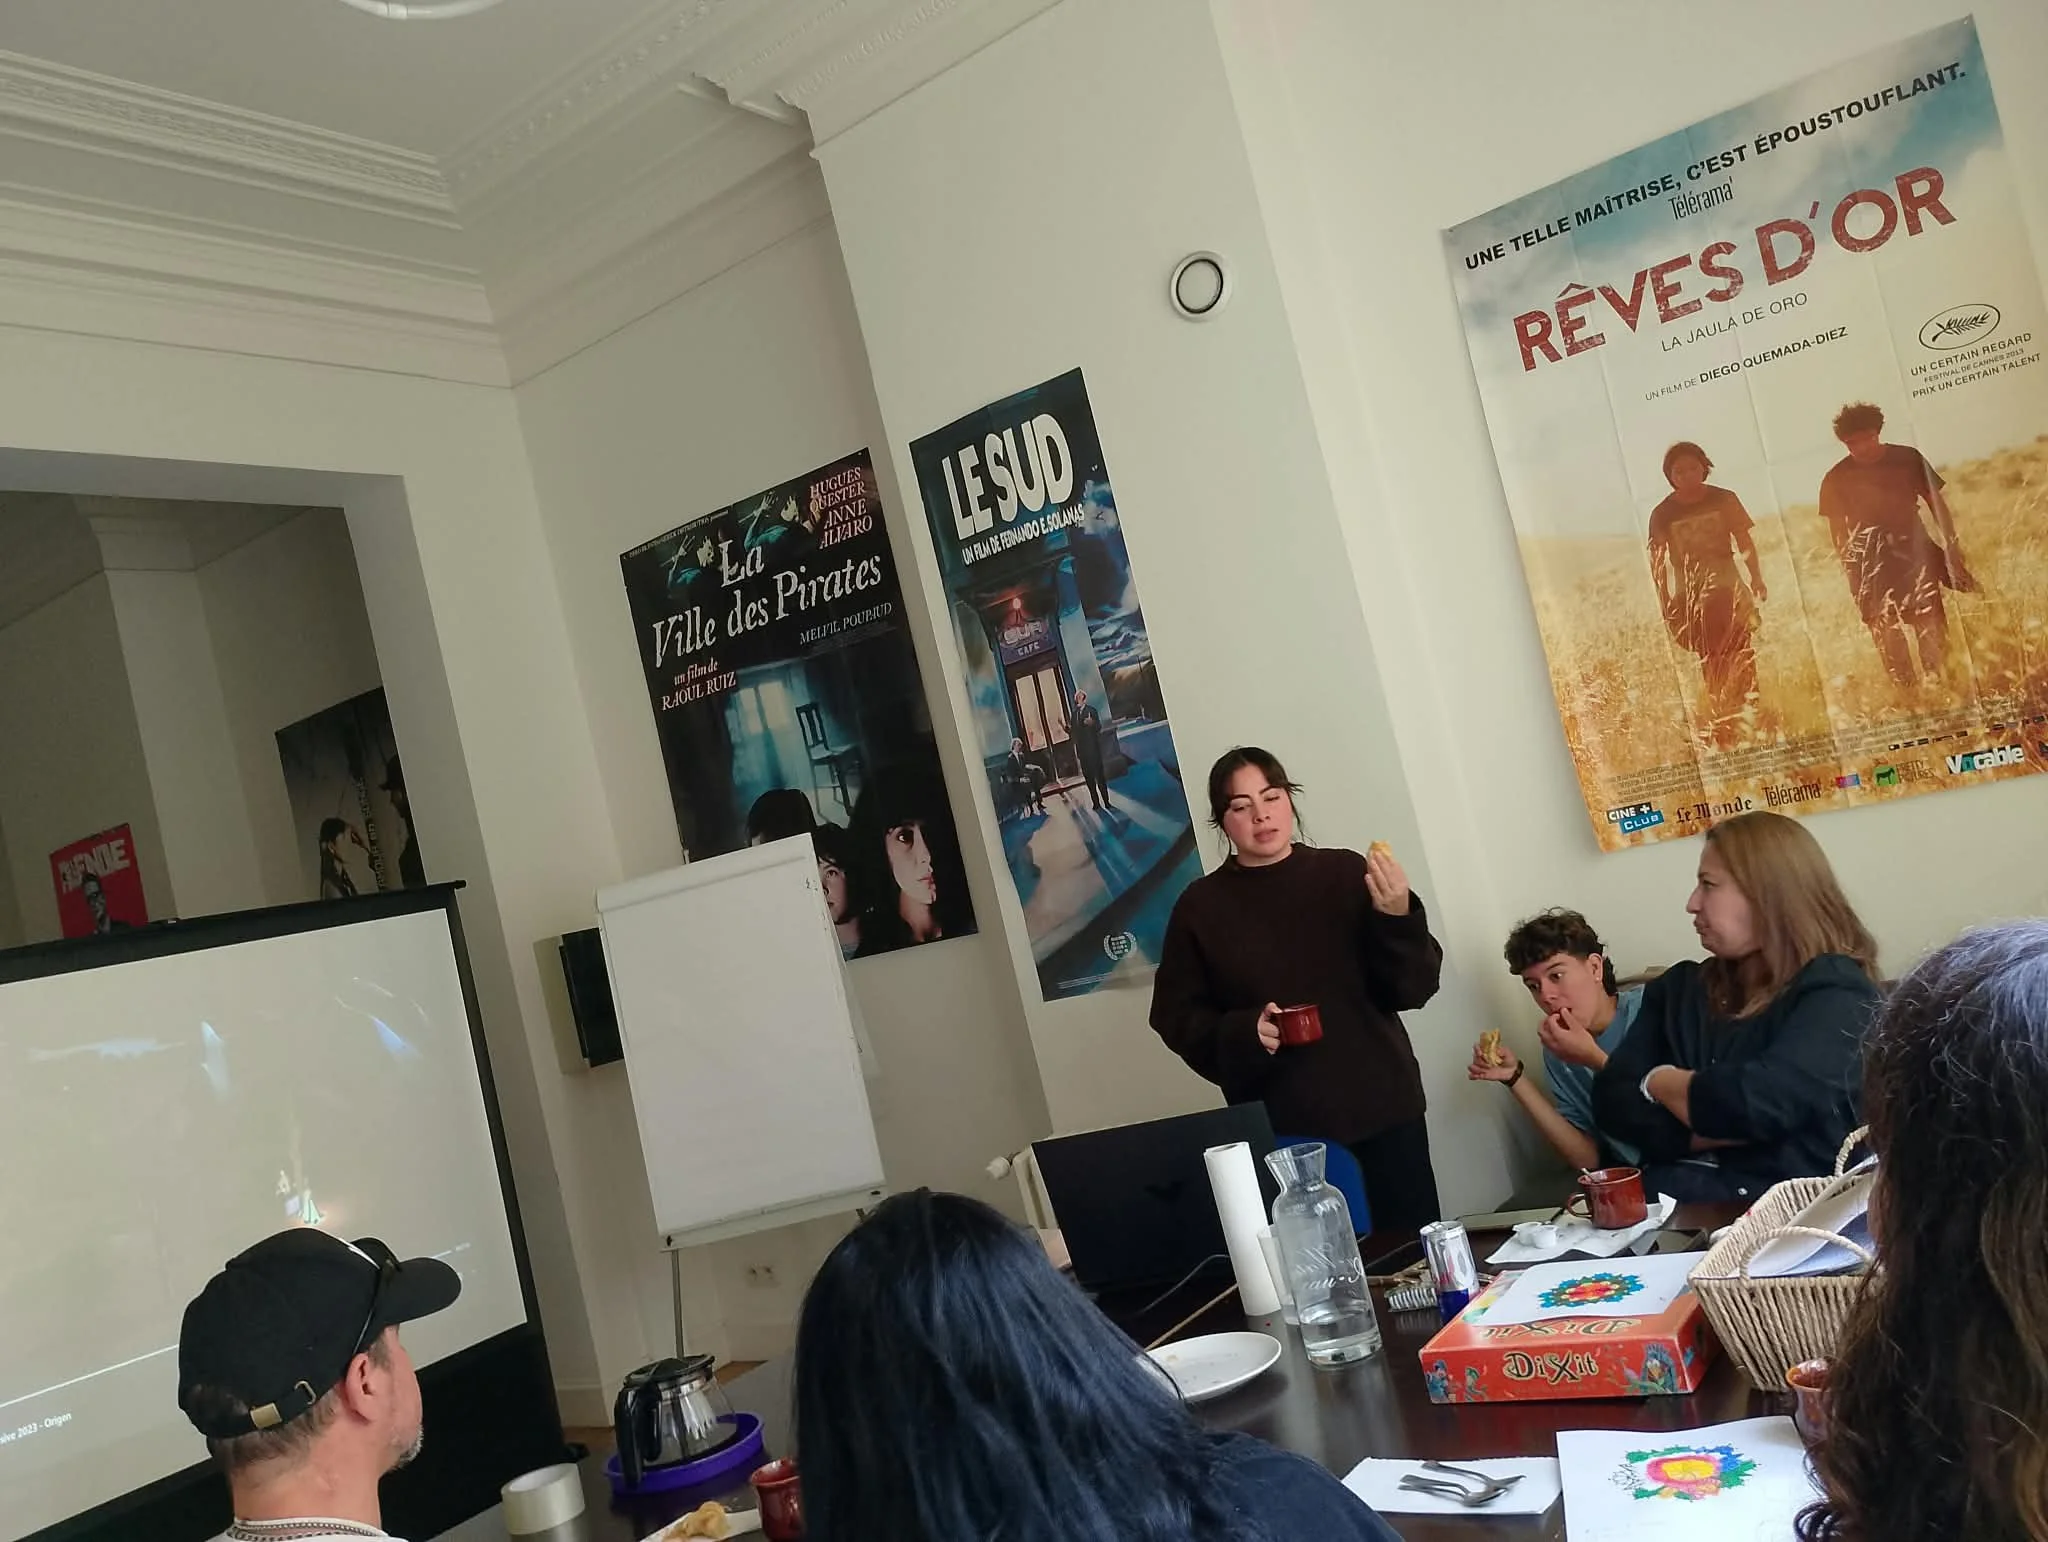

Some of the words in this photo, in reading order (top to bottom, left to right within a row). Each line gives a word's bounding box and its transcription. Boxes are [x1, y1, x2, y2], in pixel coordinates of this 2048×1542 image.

[1464, 243, 1506, 271] UNE
[1509, 216, 1571, 253] TELLE
[1574, 174, 1682, 227] MAÎTRISE,
[1686, 144, 1748, 181] C'EST
[1754, 62, 1967, 155] ÉPOUSTOUFLANT.
[1513, 240, 1745, 372] RÊVES
[1755, 165, 1958, 286] D'OR
[1661, 336, 1682, 352] LA
[1686, 316, 1738, 344] JAULA
[1742, 306, 1766, 325] DE
[1769, 292, 1808, 314] ORO
[1645, 390, 1660, 401] UN
[1660, 383, 1683, 396] FILM
[1684, 378, 1697, 389] DE
[1699, 362, 1741, 383] DIEGO
[1743, 326, 1849, 369] QUEMADA-DIEZ
[1910, 364, 1928, 377] UN
[1930, 349, 1980, 370] CERTAIN
[1982, 332, 2032, 356] REGARD
[1912, 386, 1937, 399] PRIX
[1938, 380, 1953, 391] UN
[1955, 366, 2000, 386] CERTAIN
[2001, 353, 2041, 372] TALENT
[1924, 368, 1960, 383] FESTIVAL
[1961, 364, 1972, 373] DE
[1972, 355, 2005, 369] CANNES
[809, 480, 867, 514] QUESTER
[810, 466, 861, 499] HUGUES
[942, 444, 994, 541] LE
[984, 412, 1075, 523] SUD
[819, 515, 873, 549] ALVARO
[824, 498, 867, 529] ANNE
[962, 543, 976, 565] UN
[974, 539, 992, 561] FILM
[990, 536, 1002, 554] DE
[1000, 520, 1040, 551] FERNANDO
[652, 606, 717, 669] Ville
[727, 588, 769, 637] des
[772, 555, 882, 621] Pirates
[800, 620, 840, 645] MELVIL
[843, 602, 892, 630] POUPAUD
[662, 683, 704, 711] RAOUL
[706, 671, 737, 695] RUIZ
[674, 673, 686, 686] un
[685, 663, 707, 685] film
[707, 656, 719, 673] de
[1676, 807, 1692, 825] Le
[1694, 796, 1753, 820] Monde
[18, 1422, 38, 1438] 2023
